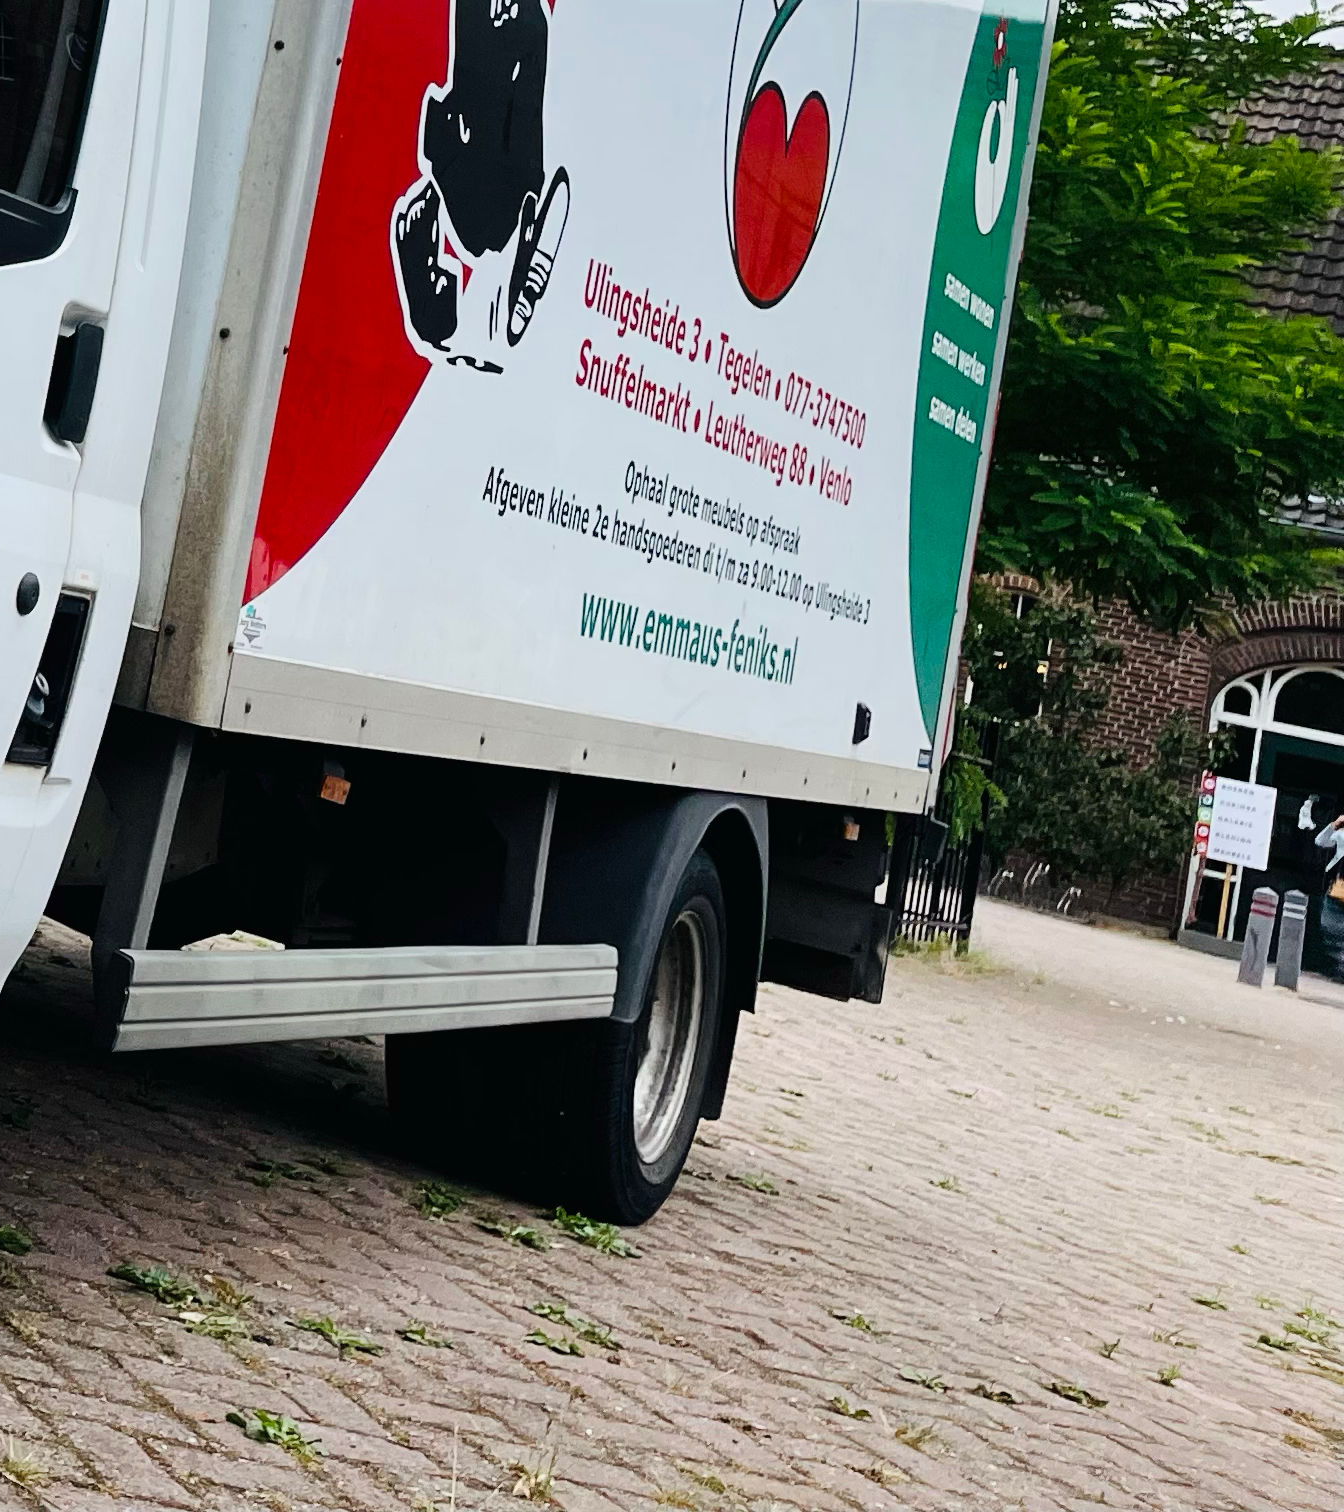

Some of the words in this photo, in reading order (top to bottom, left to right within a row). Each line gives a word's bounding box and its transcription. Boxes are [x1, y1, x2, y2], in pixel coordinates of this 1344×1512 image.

[575, 338, 691, 434] Snuffelmarkt
[704, 399, 788, 488] Leutherweg
[789, 442, 808, 486] 88
[818, 455, 853, 506] Venlo
[584, 257, 686, 356] Ulingsheide
[688, 317, 702, 363] 3
[717, 331, 772, 401] Tegelen
[784, 371, 867, 450] 077-3747500
[482, 465, 545, 517] Afgeven
[547, 485, 590, 535] kleine
[591, 503, 610, 541] 2e
[610, 507, 702, 571] handsgoederen
[702, 541, 716, 575] di
[714, 546, 736, 584] t/m
[736, 561, 750, 586] za
[802, 583, 815, 613] op
[623, 459, 670, 505] Ophaal
[668, 484, 701, 519] grote
[700, 497, 745, 535] meubels
[745, 514, 759, 547] op
[760, 514, 801, 556] afspraak
[580, 592, 799, 685] www.emmaus-feniks.nl
